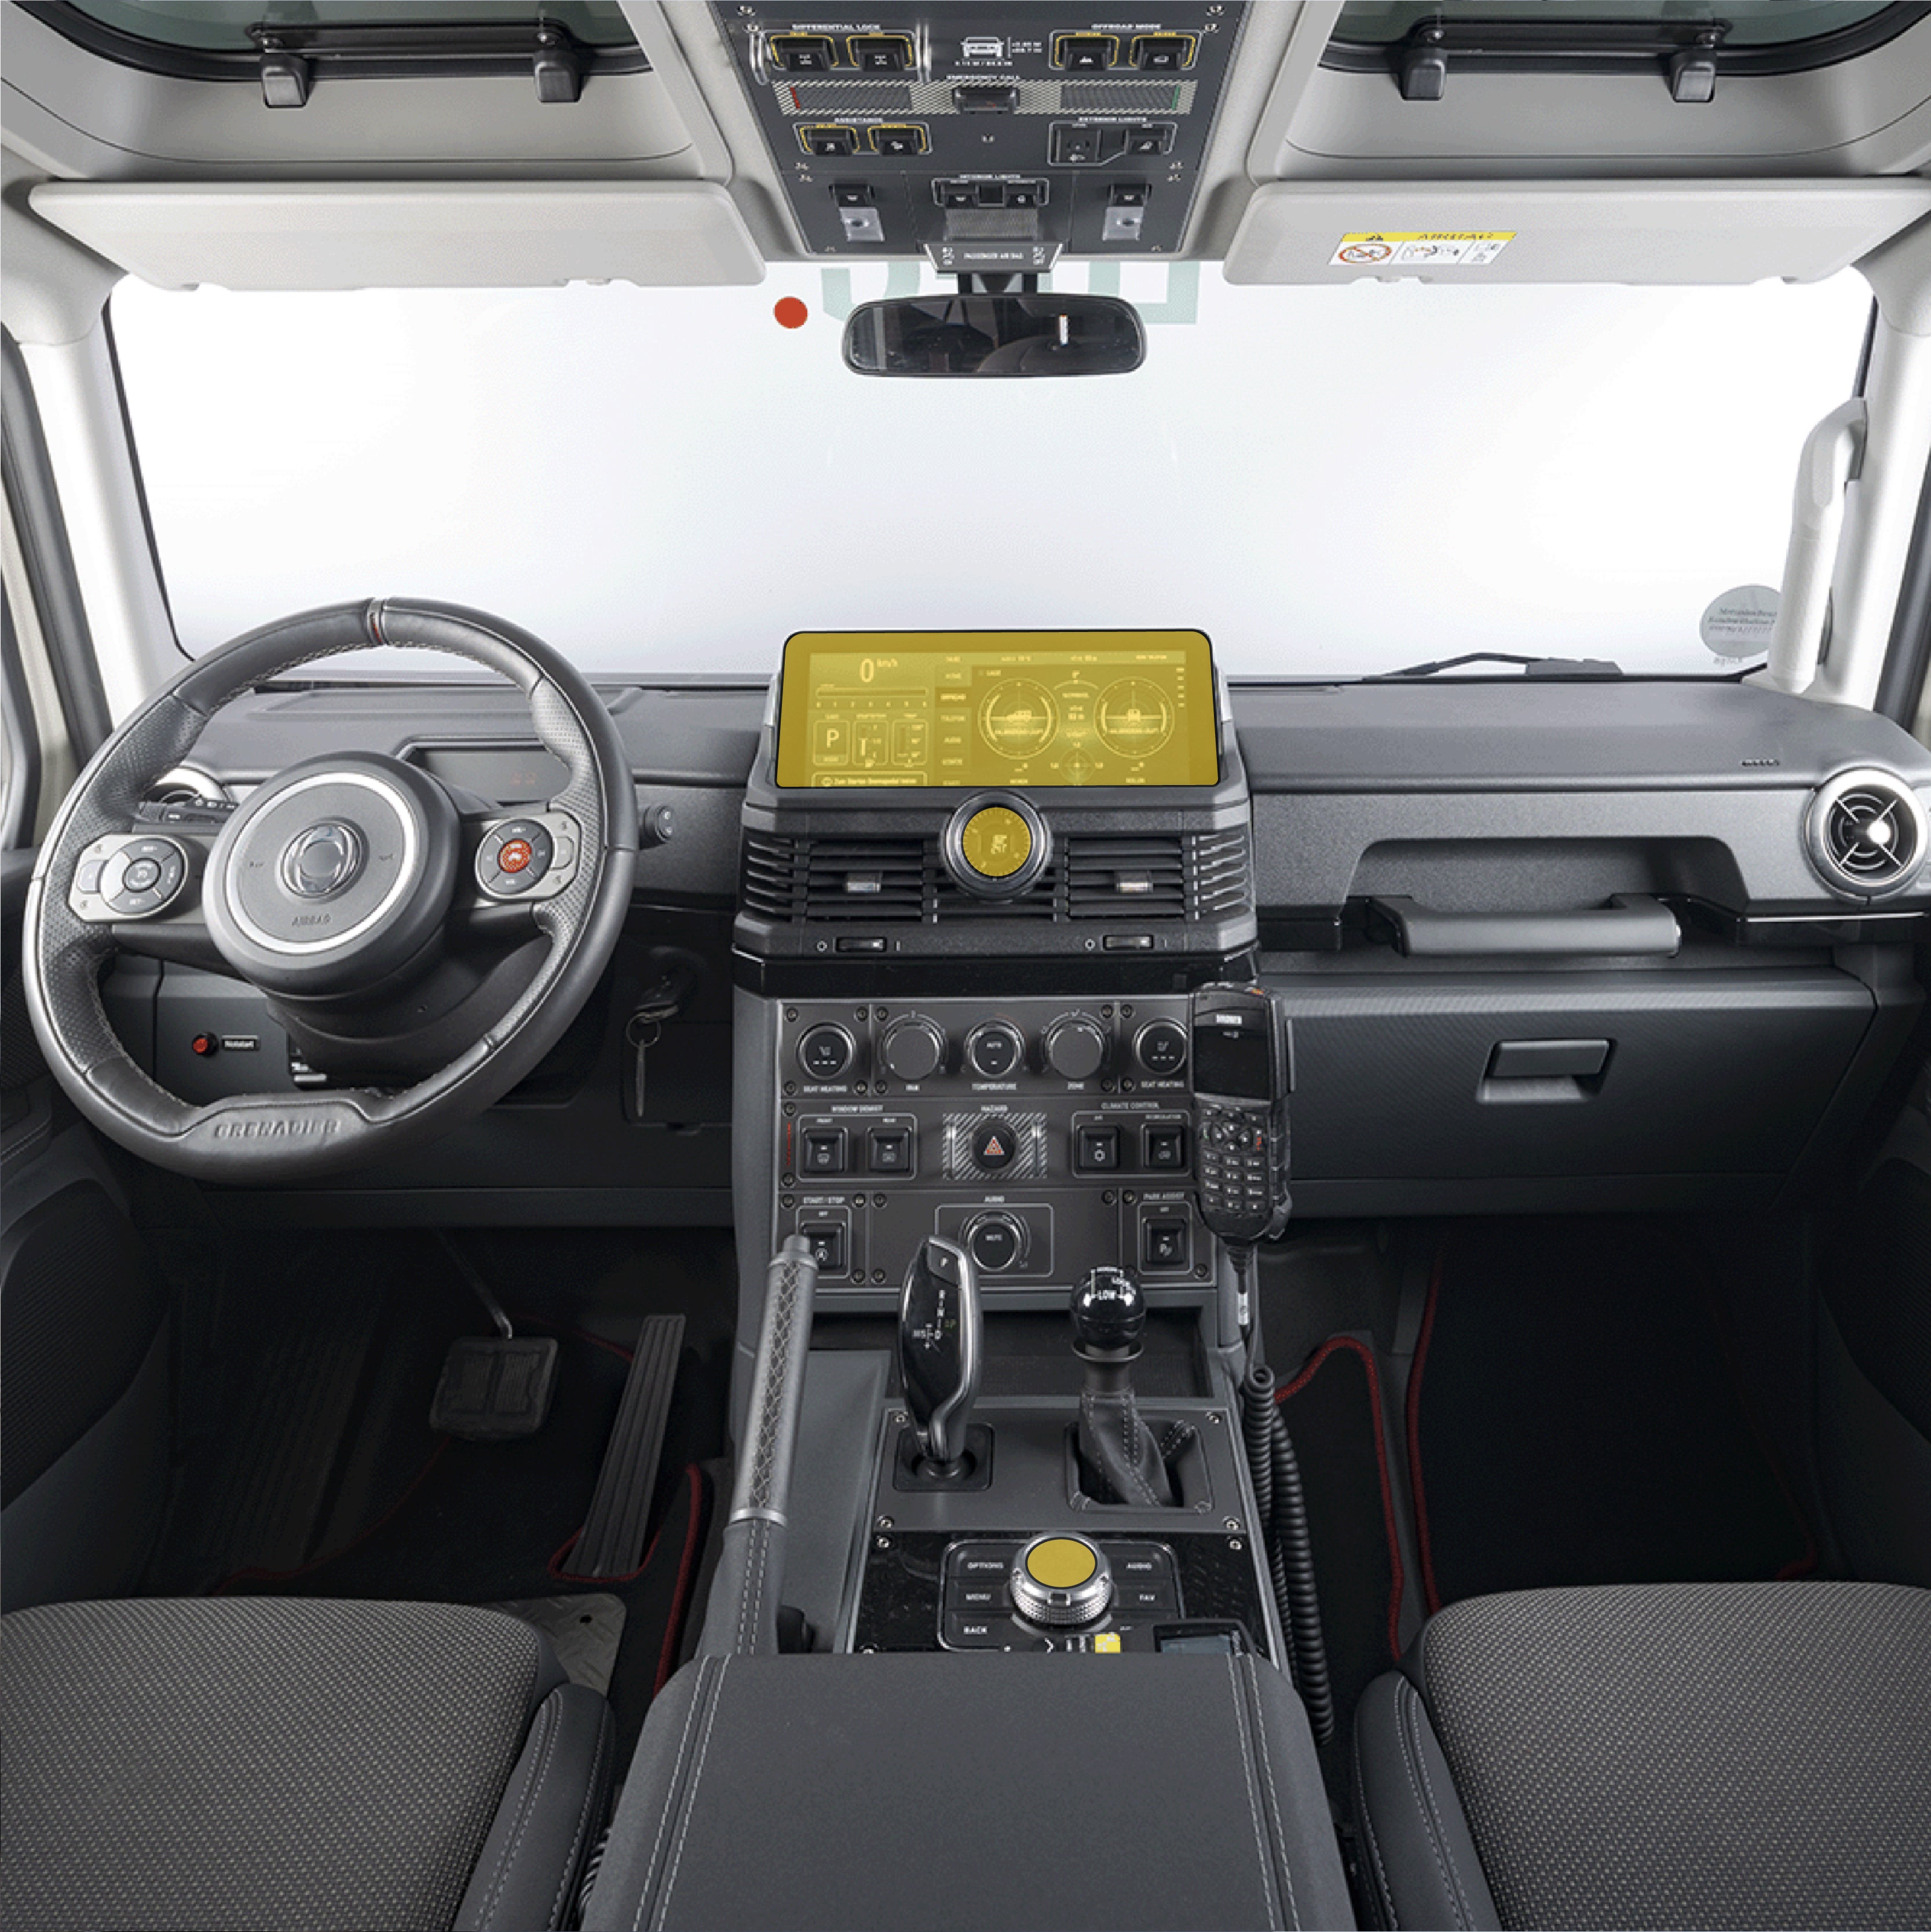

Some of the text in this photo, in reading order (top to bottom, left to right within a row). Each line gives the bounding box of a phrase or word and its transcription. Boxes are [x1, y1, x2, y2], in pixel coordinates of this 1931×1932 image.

[860, 659, 875, 682] 0
[826, 728, 840, 748] P
[215, 1120, 337, 1138] GRENADIER
[966, 1561, 1005, 1571] OPTIONS
[1125, 1562, 1154, 1571] AUDIO
[964, 1593, 992, 1602] MENU
